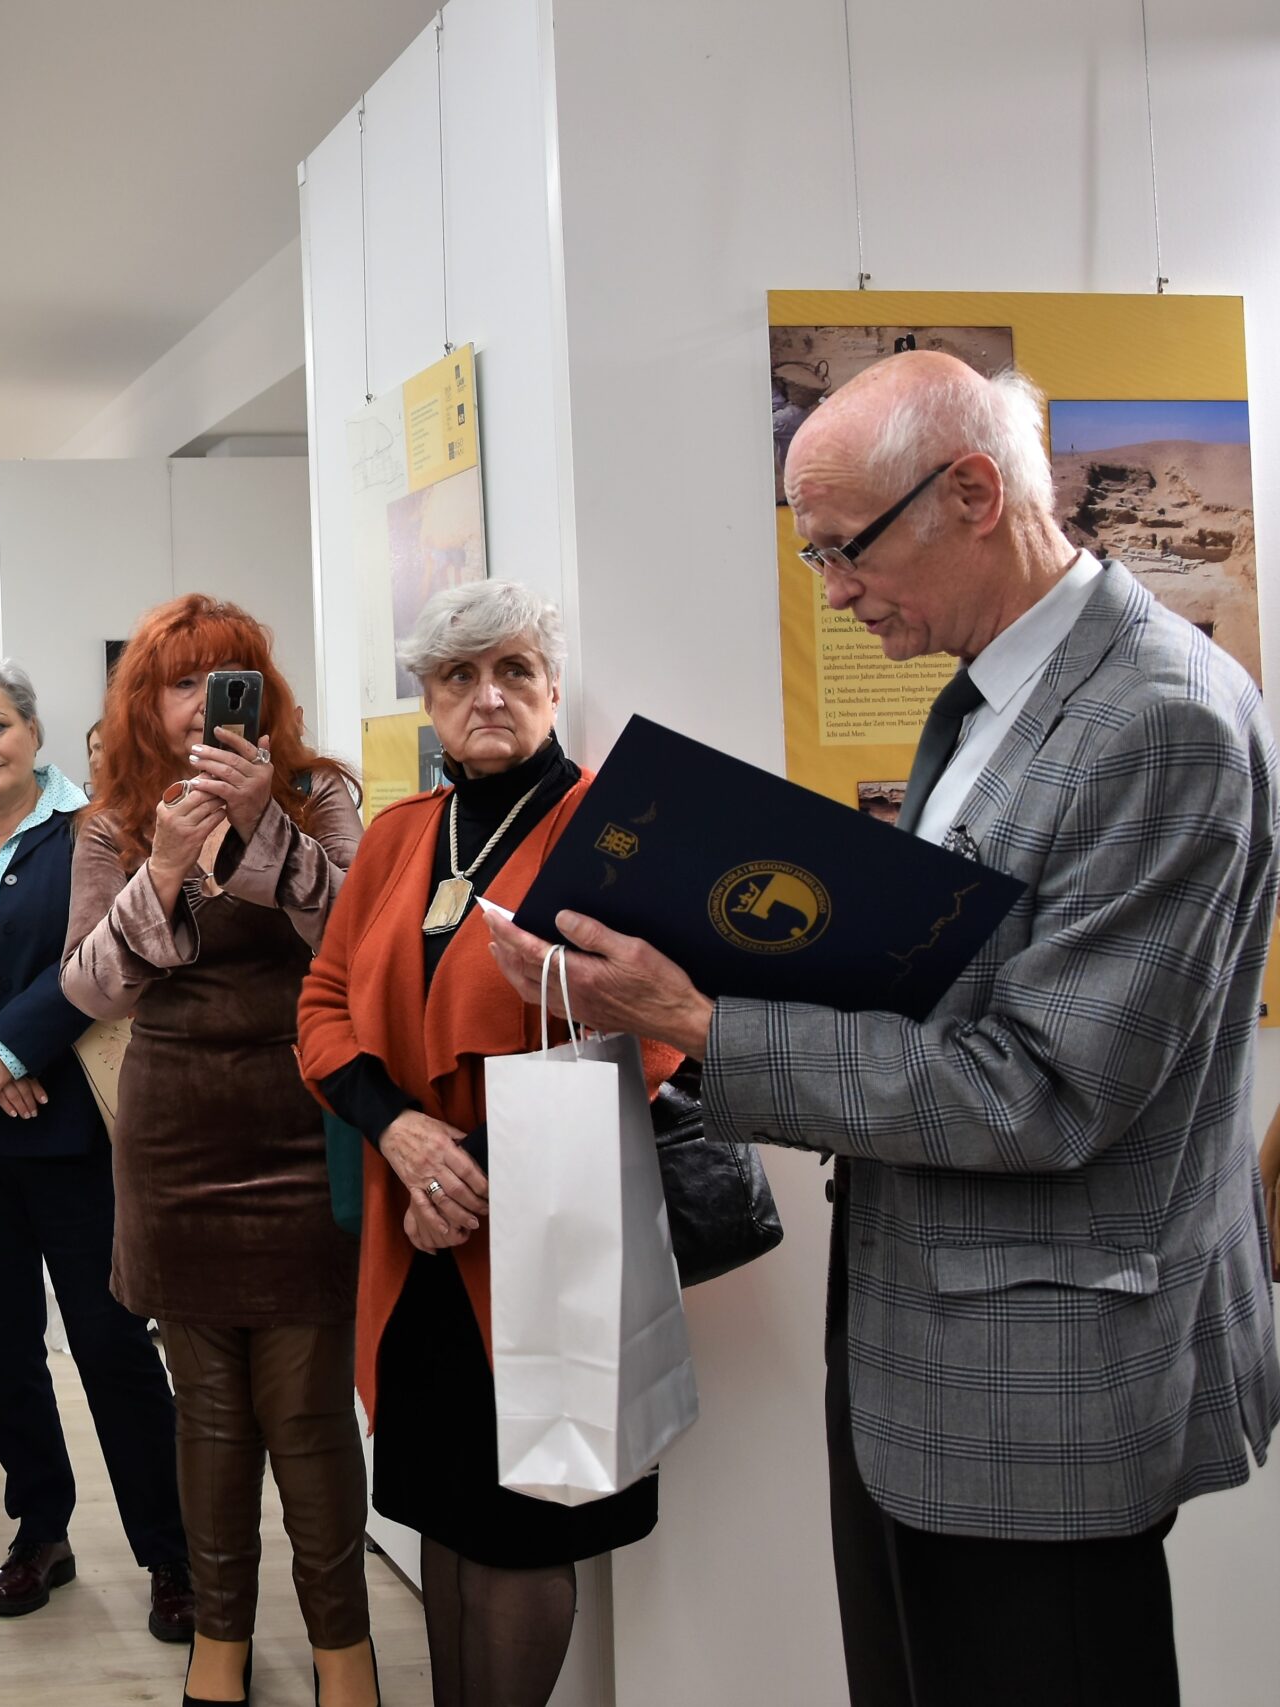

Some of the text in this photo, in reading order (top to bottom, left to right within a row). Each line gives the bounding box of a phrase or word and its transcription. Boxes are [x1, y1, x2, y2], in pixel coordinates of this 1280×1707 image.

[855, 642, 883, 650] Westwan
[841, 652, 852, 660] und
[749, 863, 793, 874] REGIONU
